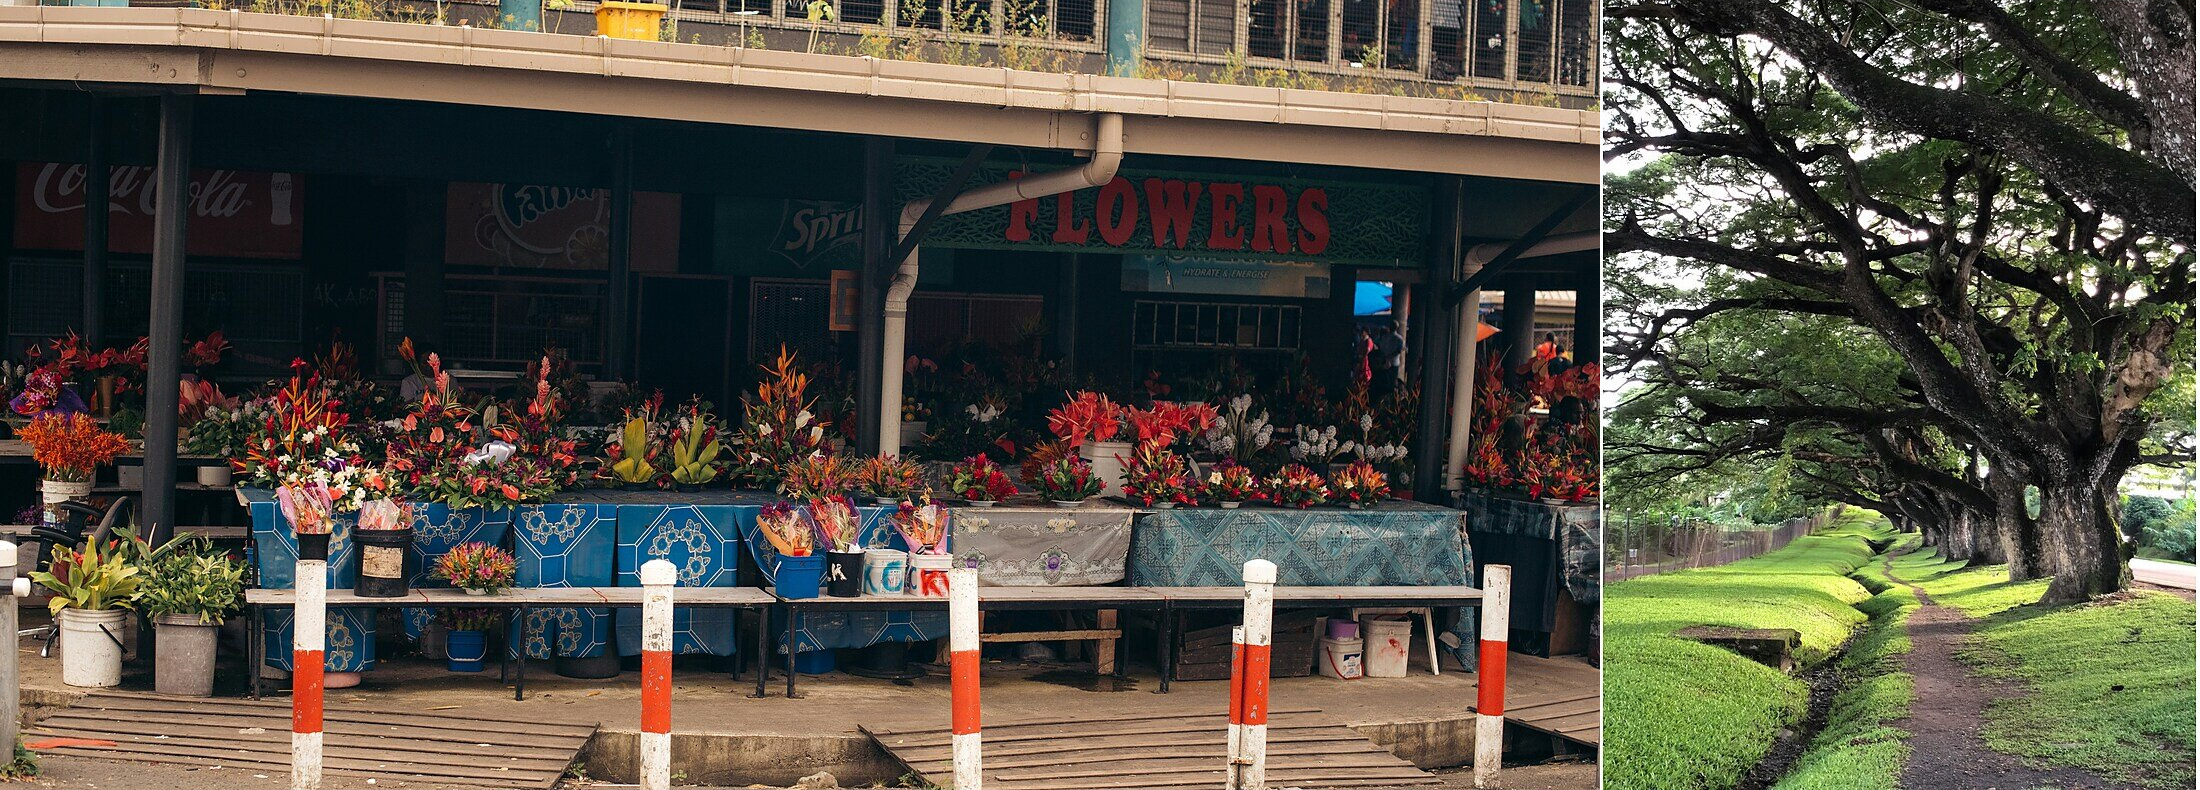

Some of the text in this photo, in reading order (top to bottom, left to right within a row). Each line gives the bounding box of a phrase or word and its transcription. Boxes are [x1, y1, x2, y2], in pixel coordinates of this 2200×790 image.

[784, 203, 864, 254] Spri
[1004, 170, 1331, 256] FLOWERS
[1183, 267, 1221, 278] HYDRATE
[1231, 269, 1271, 280] ENERGISE
